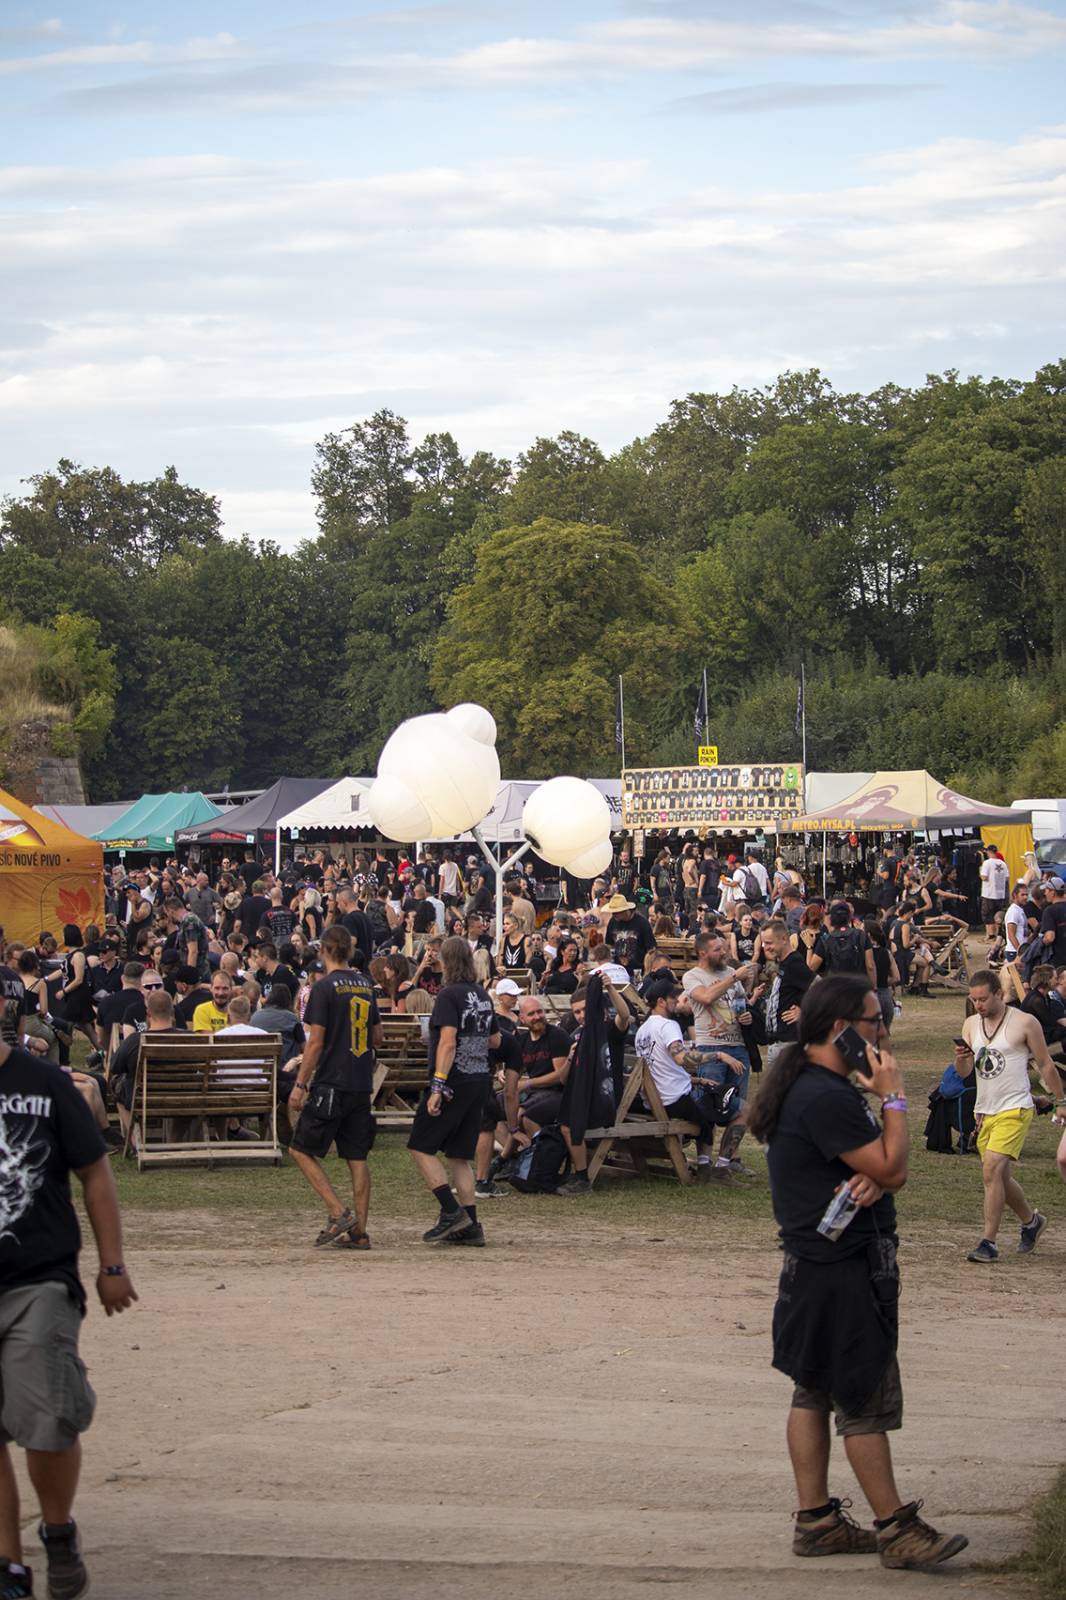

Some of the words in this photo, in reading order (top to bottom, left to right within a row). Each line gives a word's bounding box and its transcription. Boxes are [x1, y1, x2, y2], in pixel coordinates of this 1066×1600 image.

[701, 748, 715, 756] RAIN
[14, 851, 39, 867] NOVÉ
[40, 853, 61, 867] PIVO
